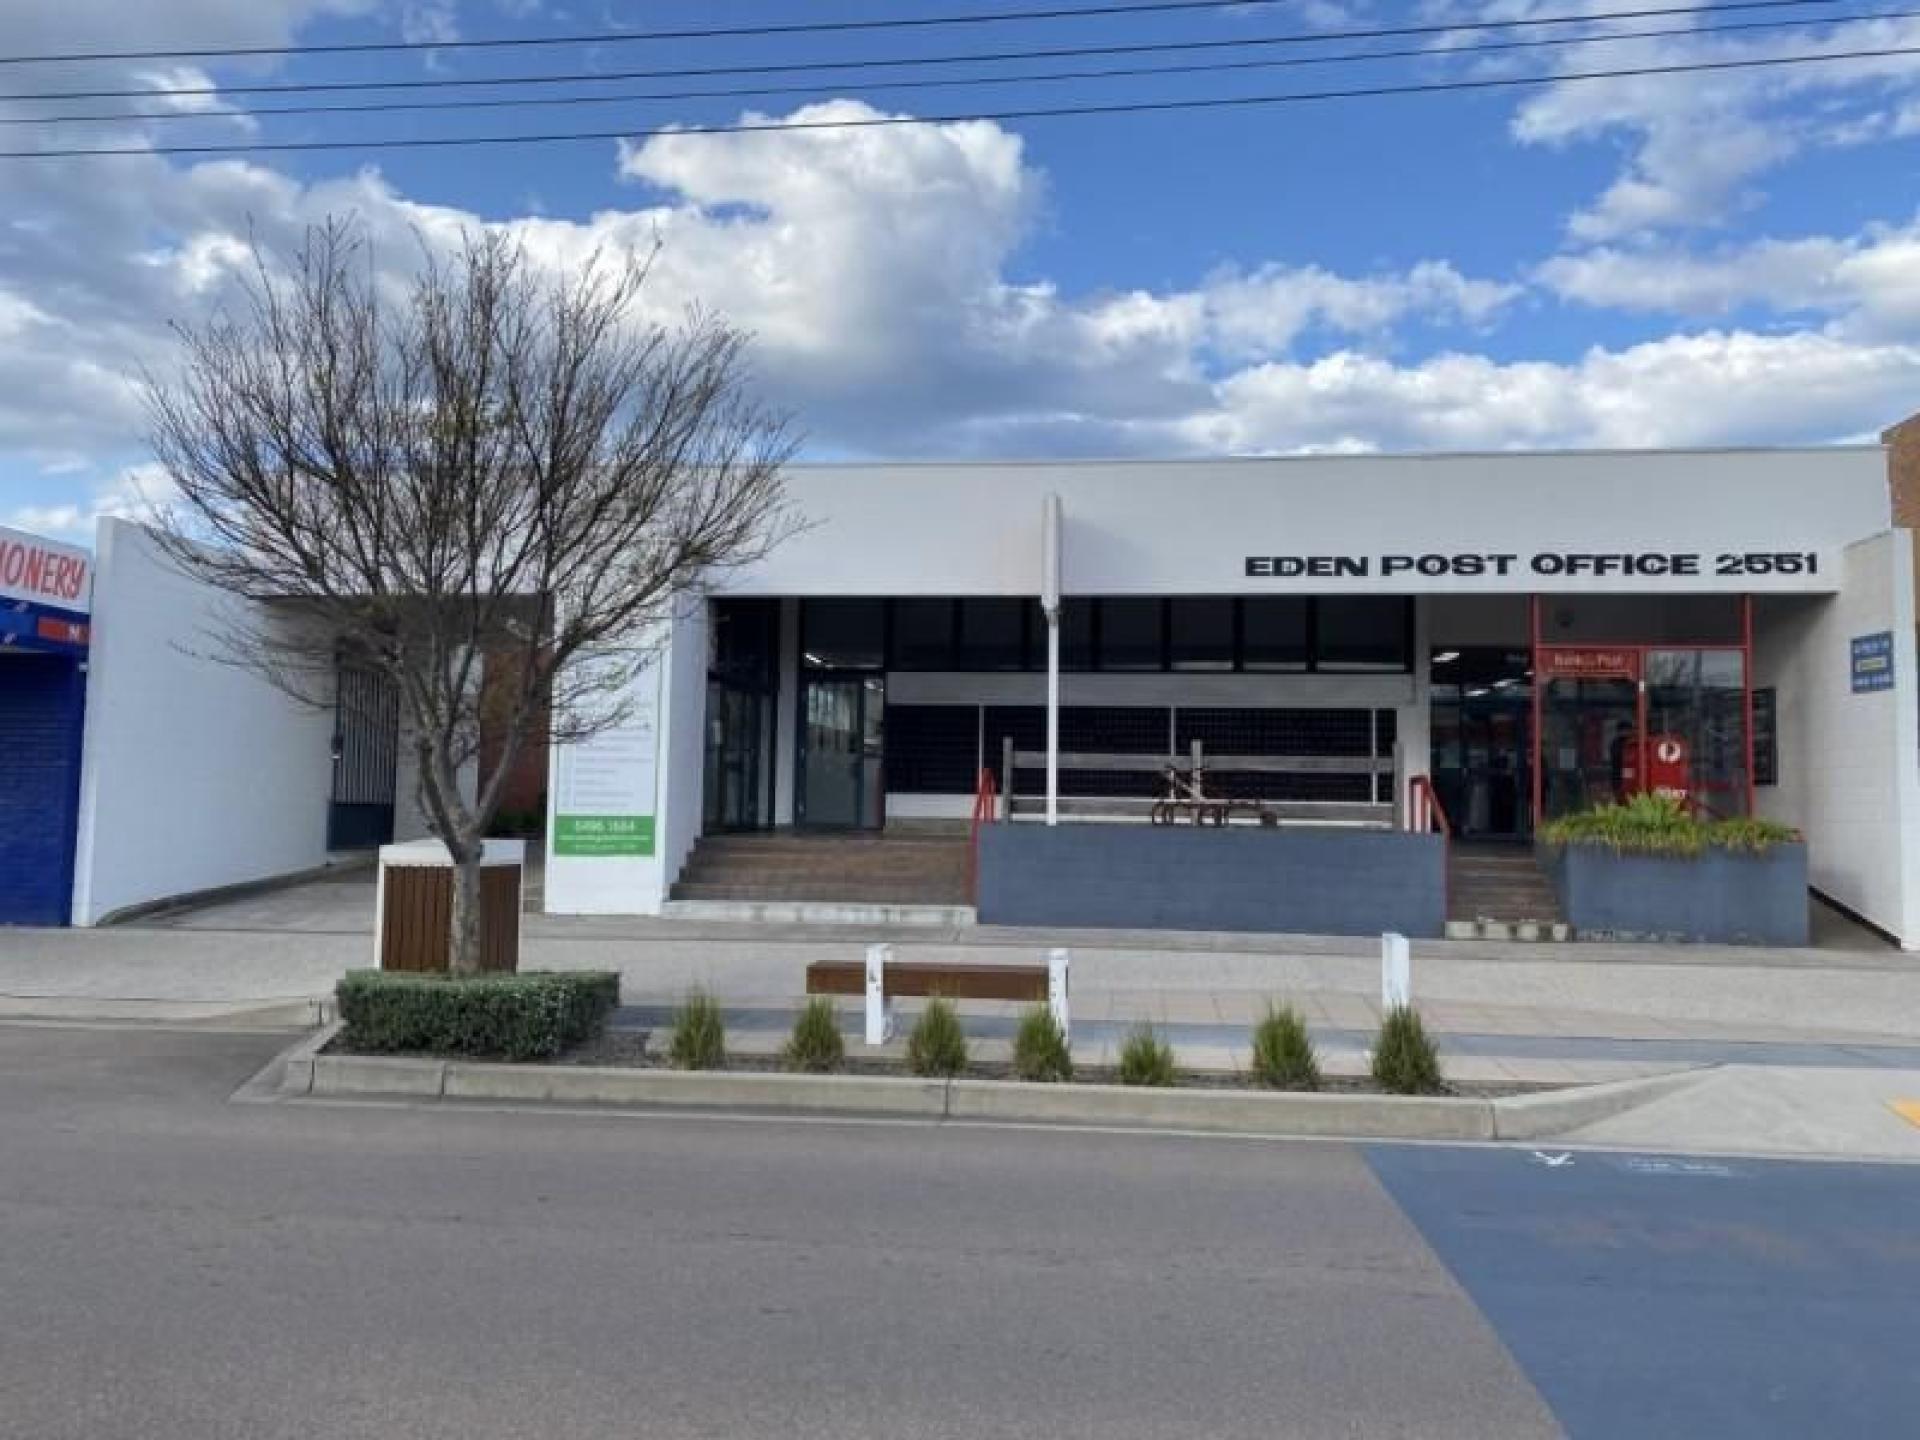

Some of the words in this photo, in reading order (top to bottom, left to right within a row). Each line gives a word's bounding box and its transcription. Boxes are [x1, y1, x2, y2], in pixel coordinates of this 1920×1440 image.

[1244, 556, 1369, 577] EDEN
[1379, 553, 1518, 577] POST
[1530, 553, 1700, 576] OFFICE
[1714, 552, 1818, 576] 2551
